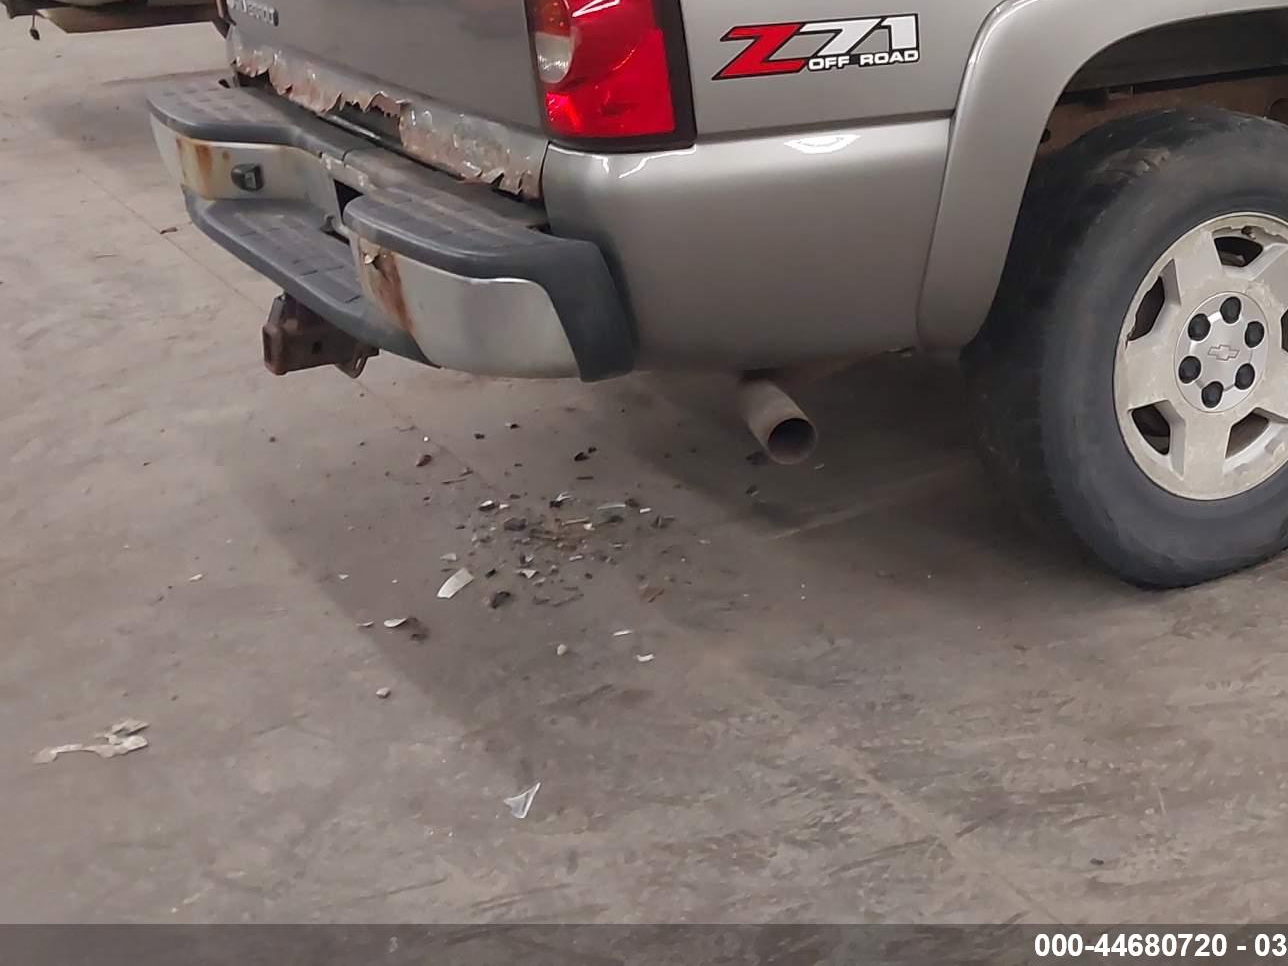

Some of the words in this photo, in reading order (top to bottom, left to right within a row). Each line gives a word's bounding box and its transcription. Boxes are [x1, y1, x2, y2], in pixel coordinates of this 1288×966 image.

[711, 13, 919, 81] Z71
[808, 54, 850, 71] OFF
[859, 49, 919, 67] ROAD
